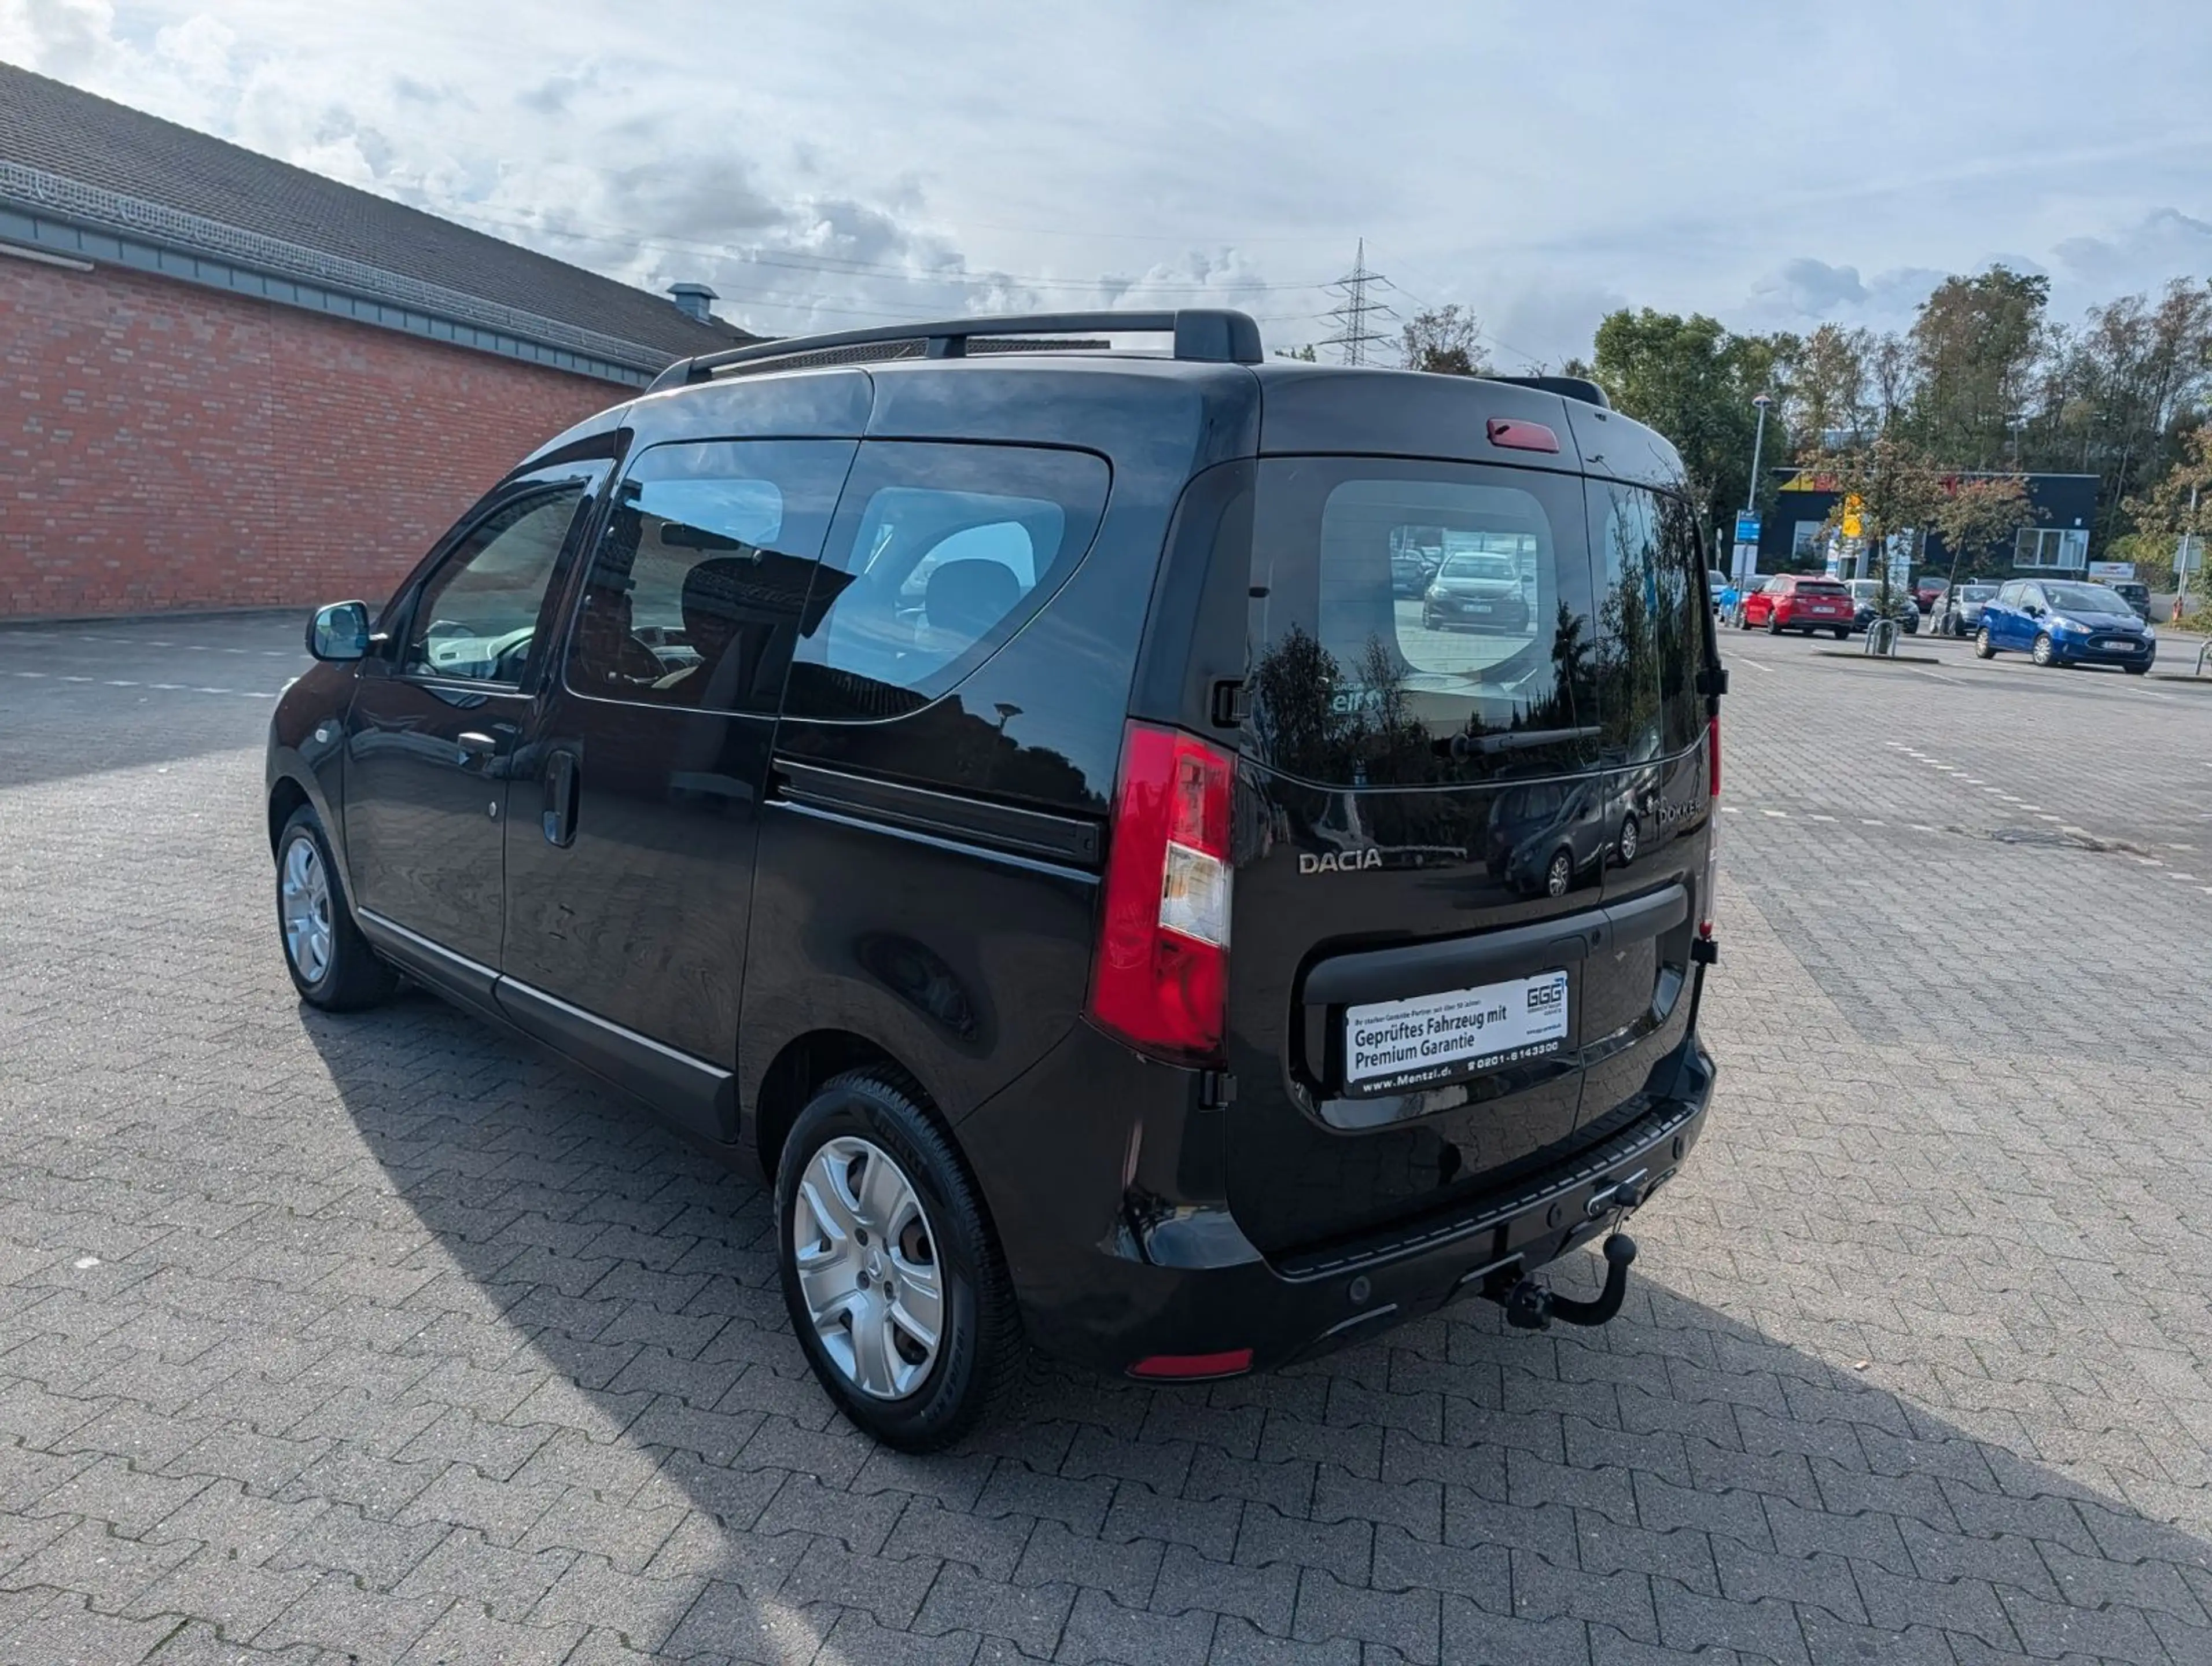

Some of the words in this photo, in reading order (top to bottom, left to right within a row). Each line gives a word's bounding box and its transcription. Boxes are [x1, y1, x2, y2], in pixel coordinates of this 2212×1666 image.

[1333, 692, 1364, 712] elf
[1299, 848, 1383, 873] DACIA
[1528, 983, 1561, 1007] GGG
[1355, 1022, 1423, 1048] Geprüftes
[1427, 1012, 1484, 1035] Fahrzeug
[1487, 1005, 1507, 1023] mit
[1356, 1045, 1417, 1069] Premium
[1420, 1031, 1475, 1056] Garantie
